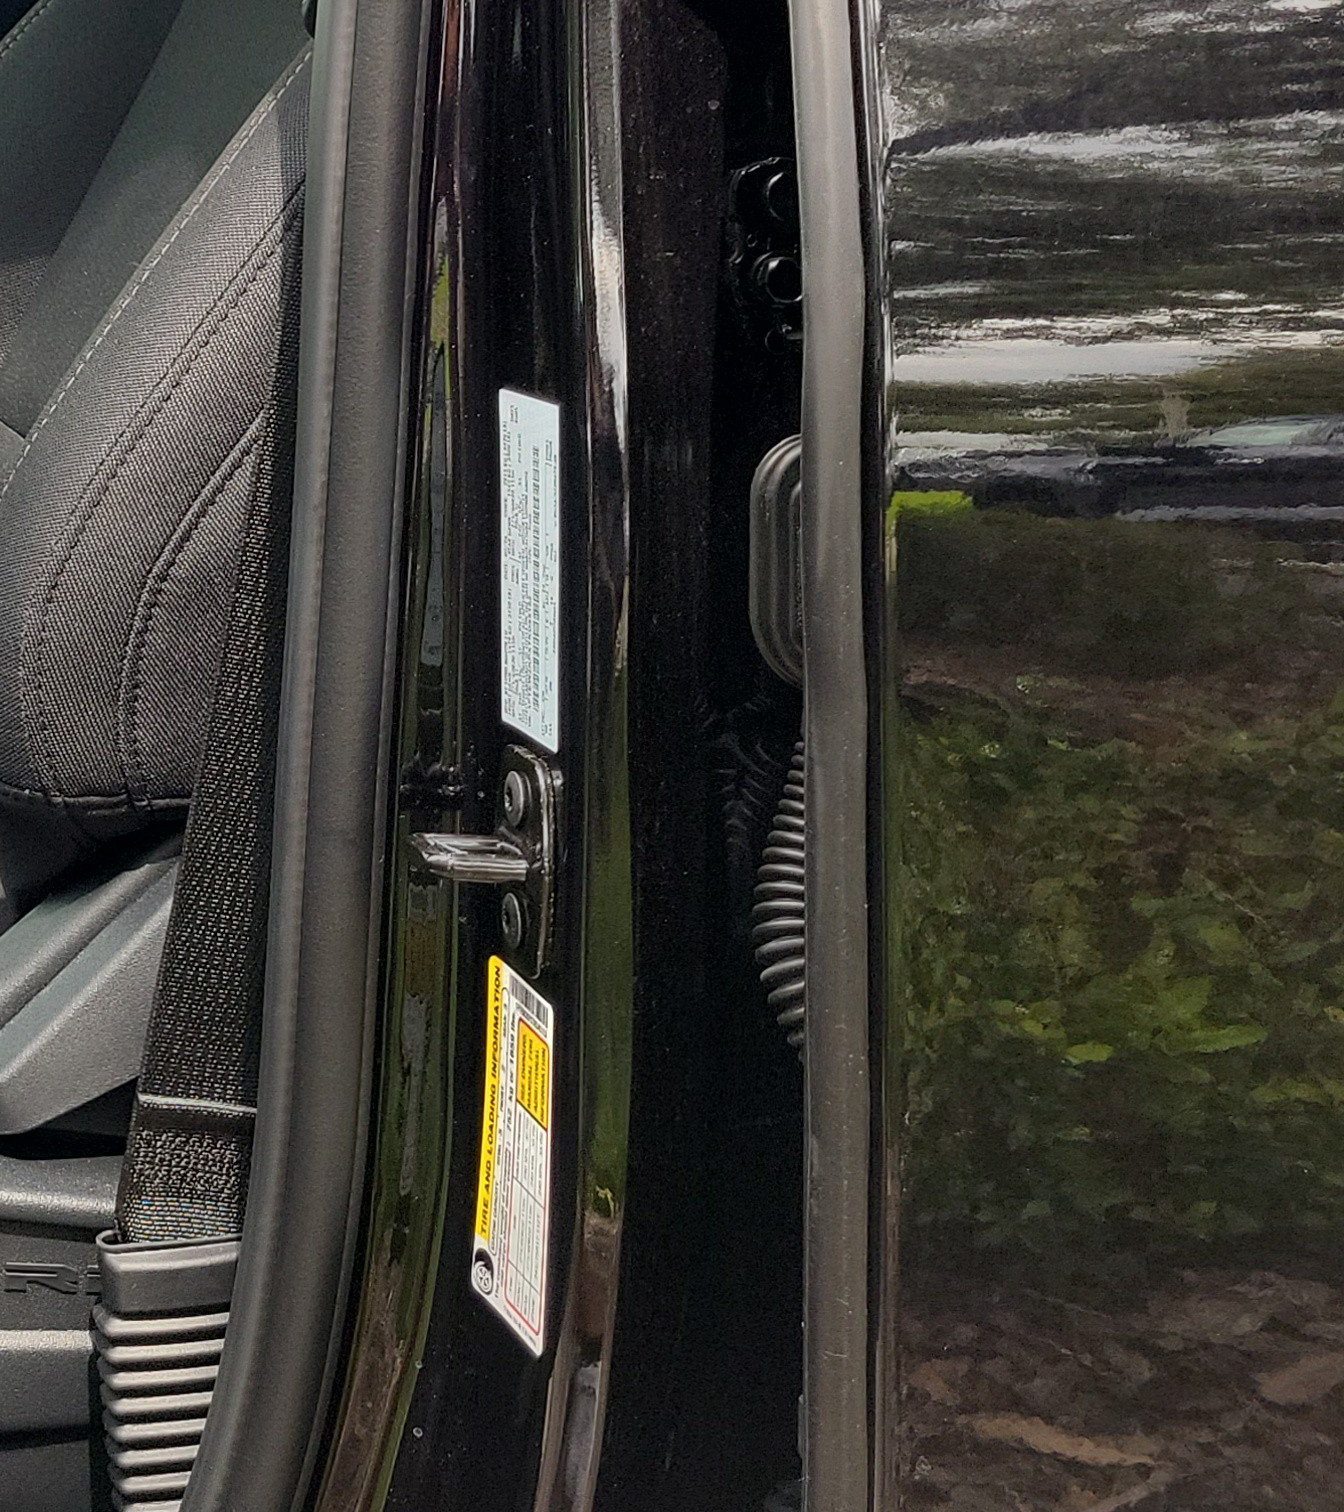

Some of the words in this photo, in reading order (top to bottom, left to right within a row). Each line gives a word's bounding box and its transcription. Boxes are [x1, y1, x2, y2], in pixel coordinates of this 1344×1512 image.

[491, 963, 500, 1080] INFORMATION
[486, 1080, 496, 1157] LOADING
[483, 1155, 491, 1195] AND
[480, 1194, 489, 1239] TIRE
